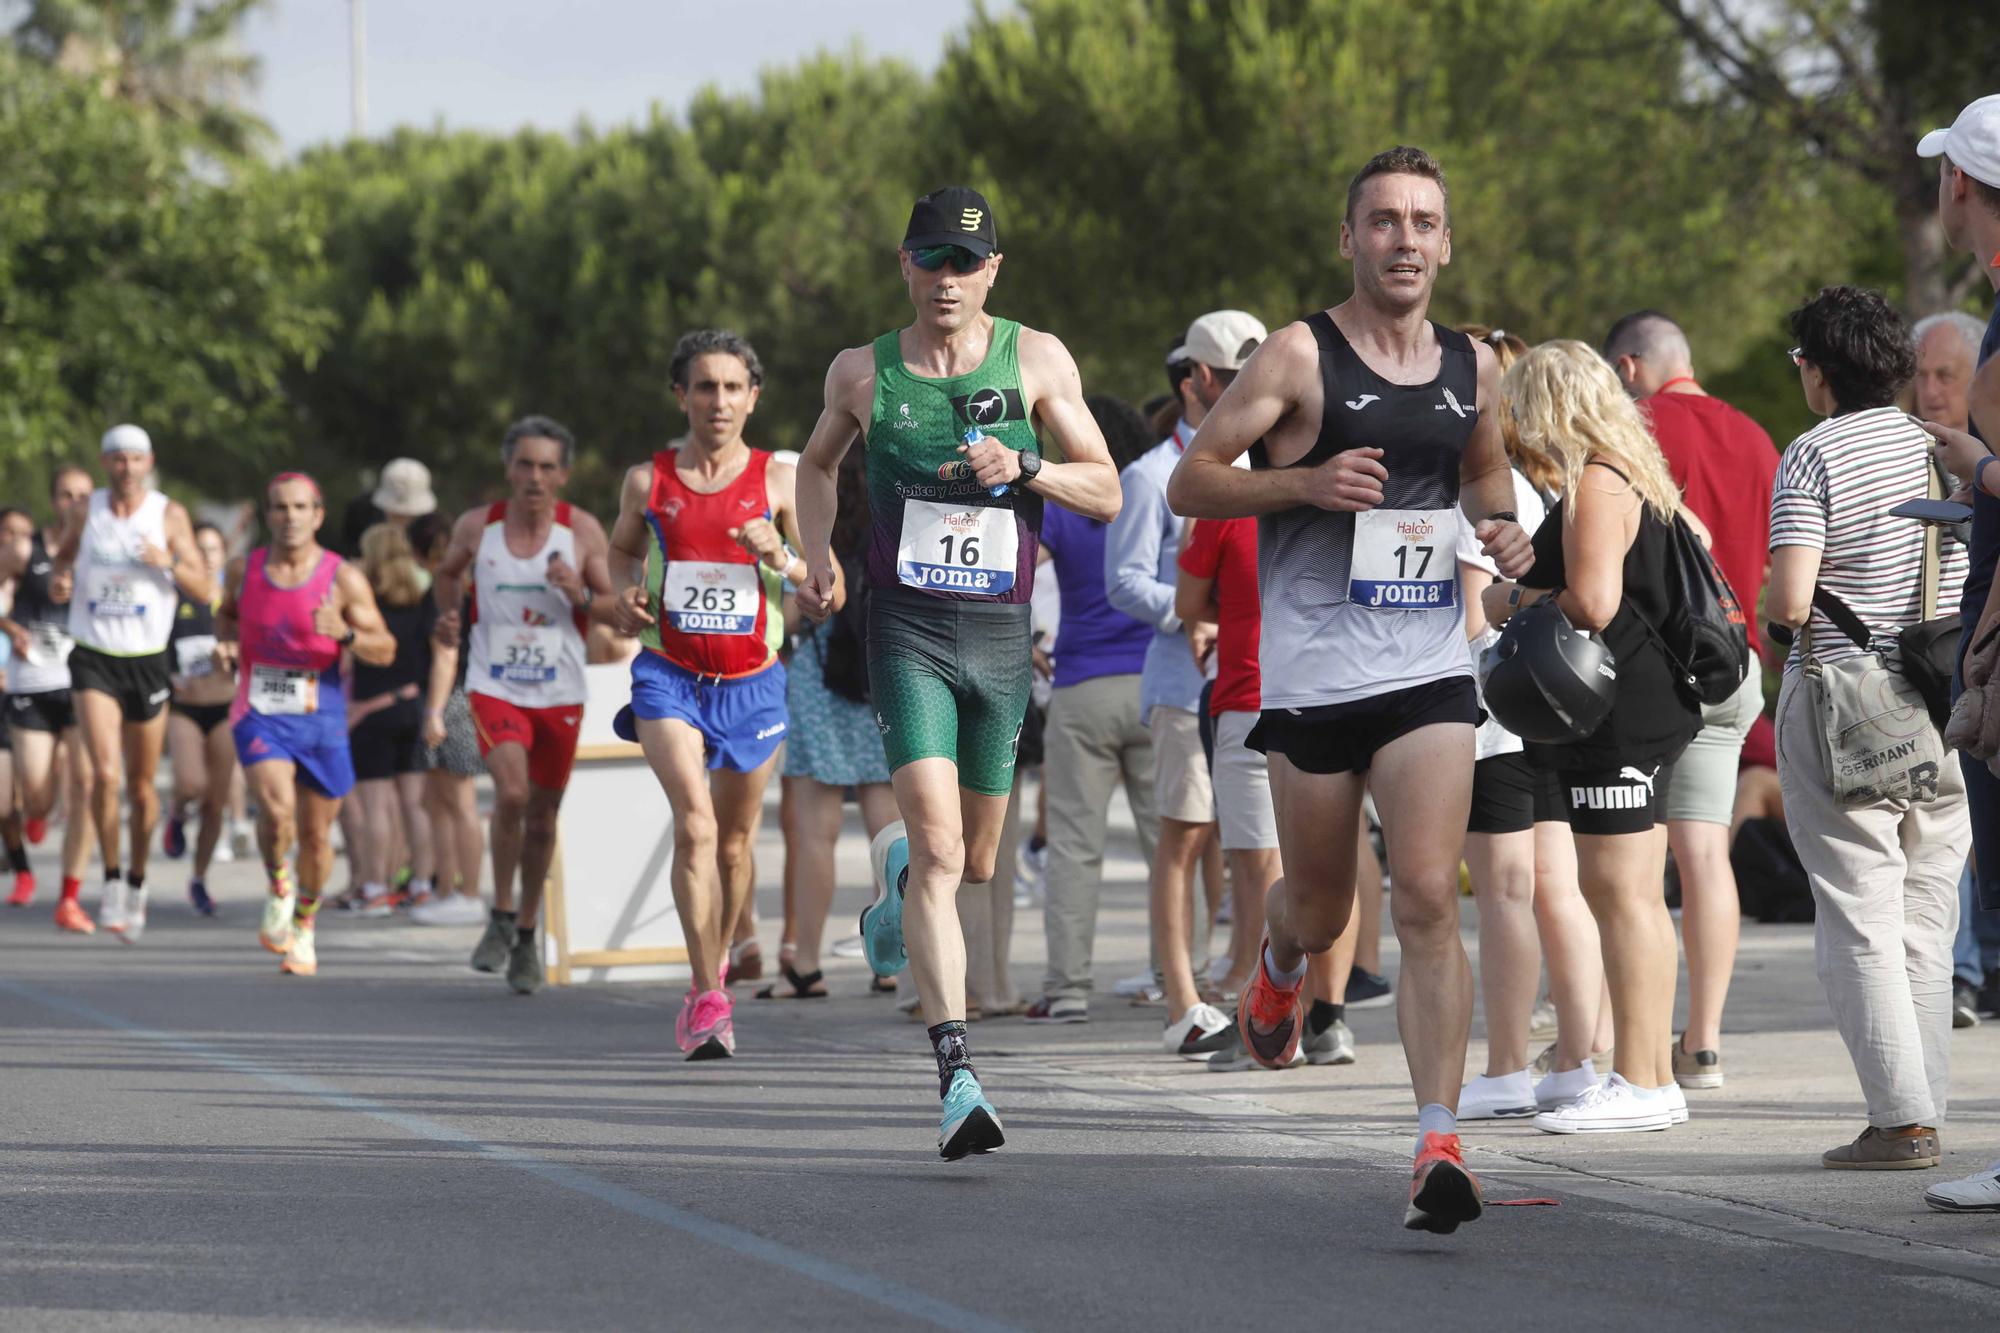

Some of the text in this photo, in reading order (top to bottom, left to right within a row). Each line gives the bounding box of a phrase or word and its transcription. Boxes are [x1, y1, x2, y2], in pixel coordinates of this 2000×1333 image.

[939, 485, 947, 498] y
[940, 535, 980, 566] 16
[1394, 545, 1434, 579] 17
[683, 586, 737, 612] 263
[504, 645, 546, 667] 325
[1841, 740, 1917, 777] GERMANY
[1571, 784, 1647, 809] PUMA
